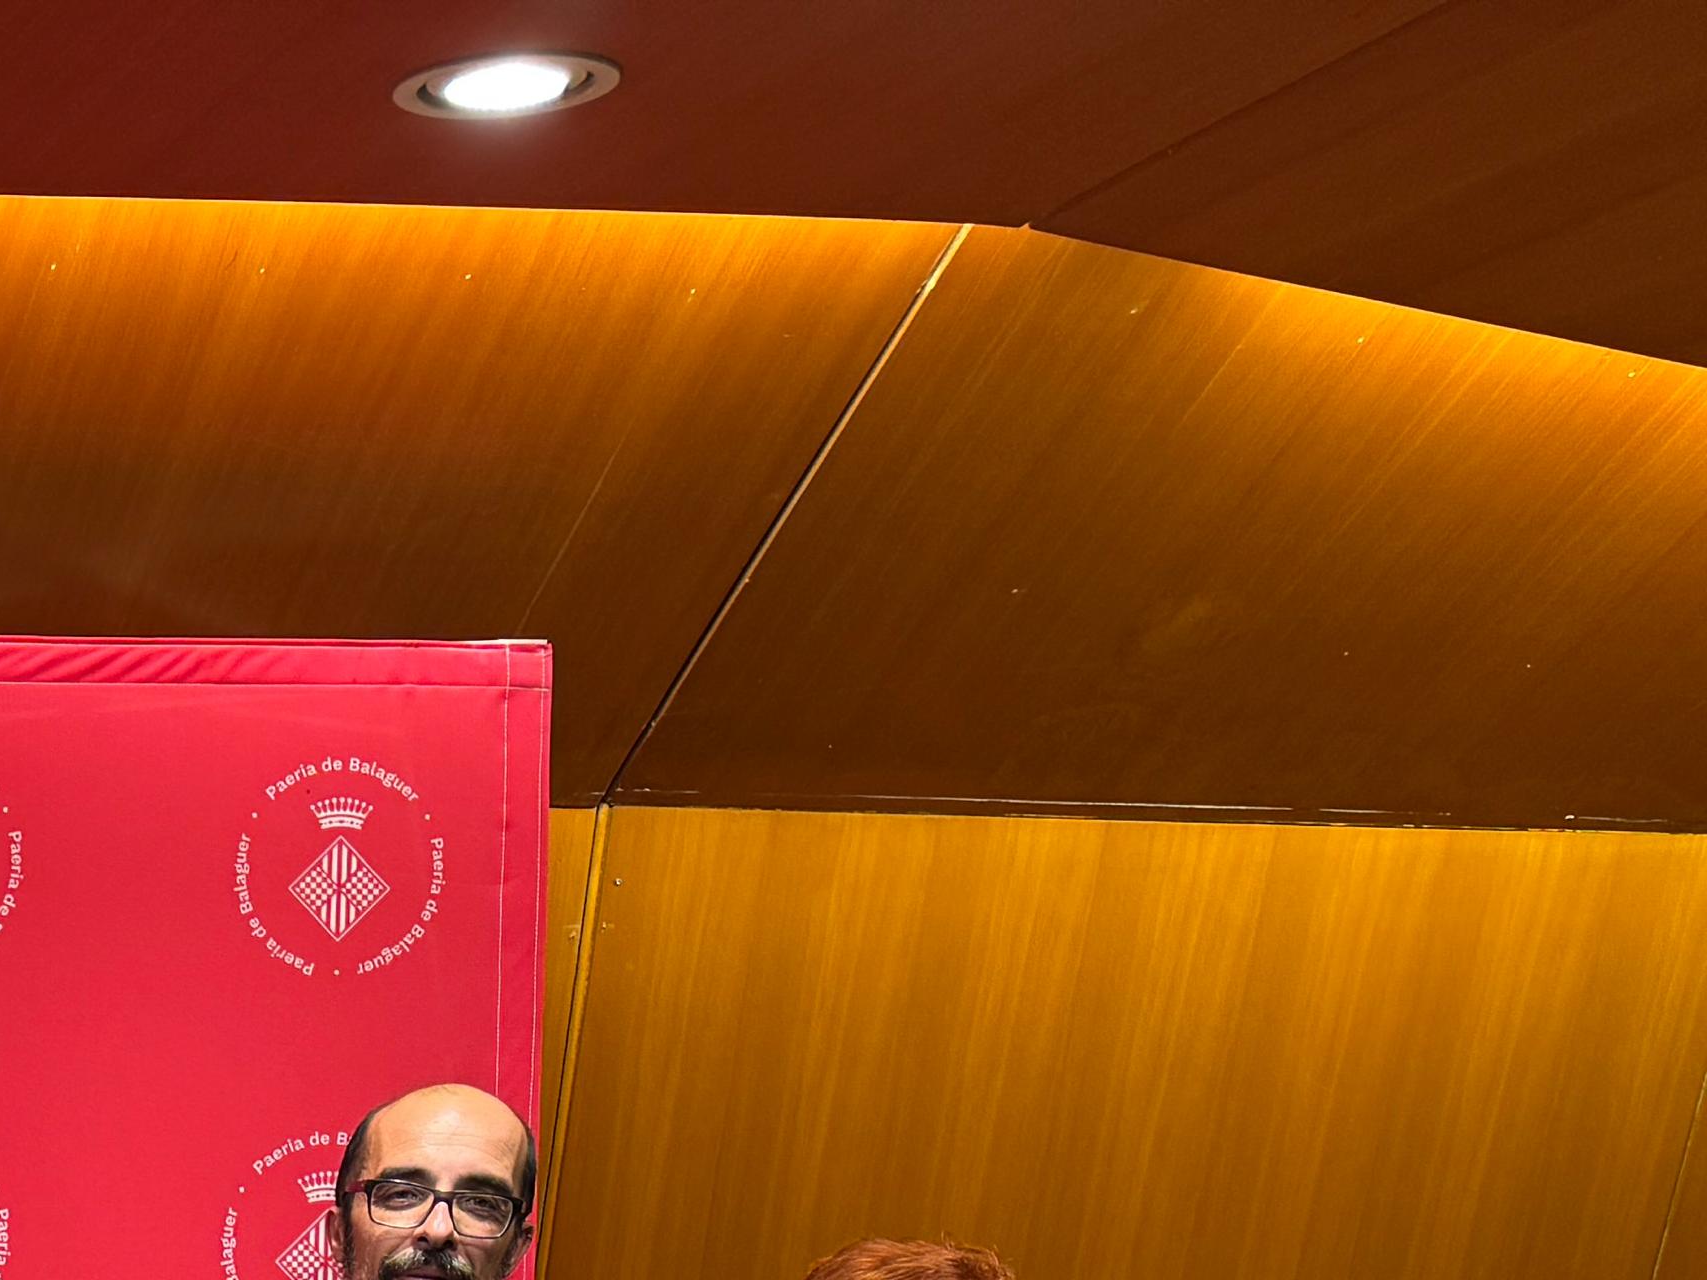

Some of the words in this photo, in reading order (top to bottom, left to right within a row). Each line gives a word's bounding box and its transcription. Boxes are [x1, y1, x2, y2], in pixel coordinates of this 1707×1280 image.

[266, 764, 317, 800] Paeria
[322, 756, 342, 772] de
[349, 757, 418, 801] Balaguer
